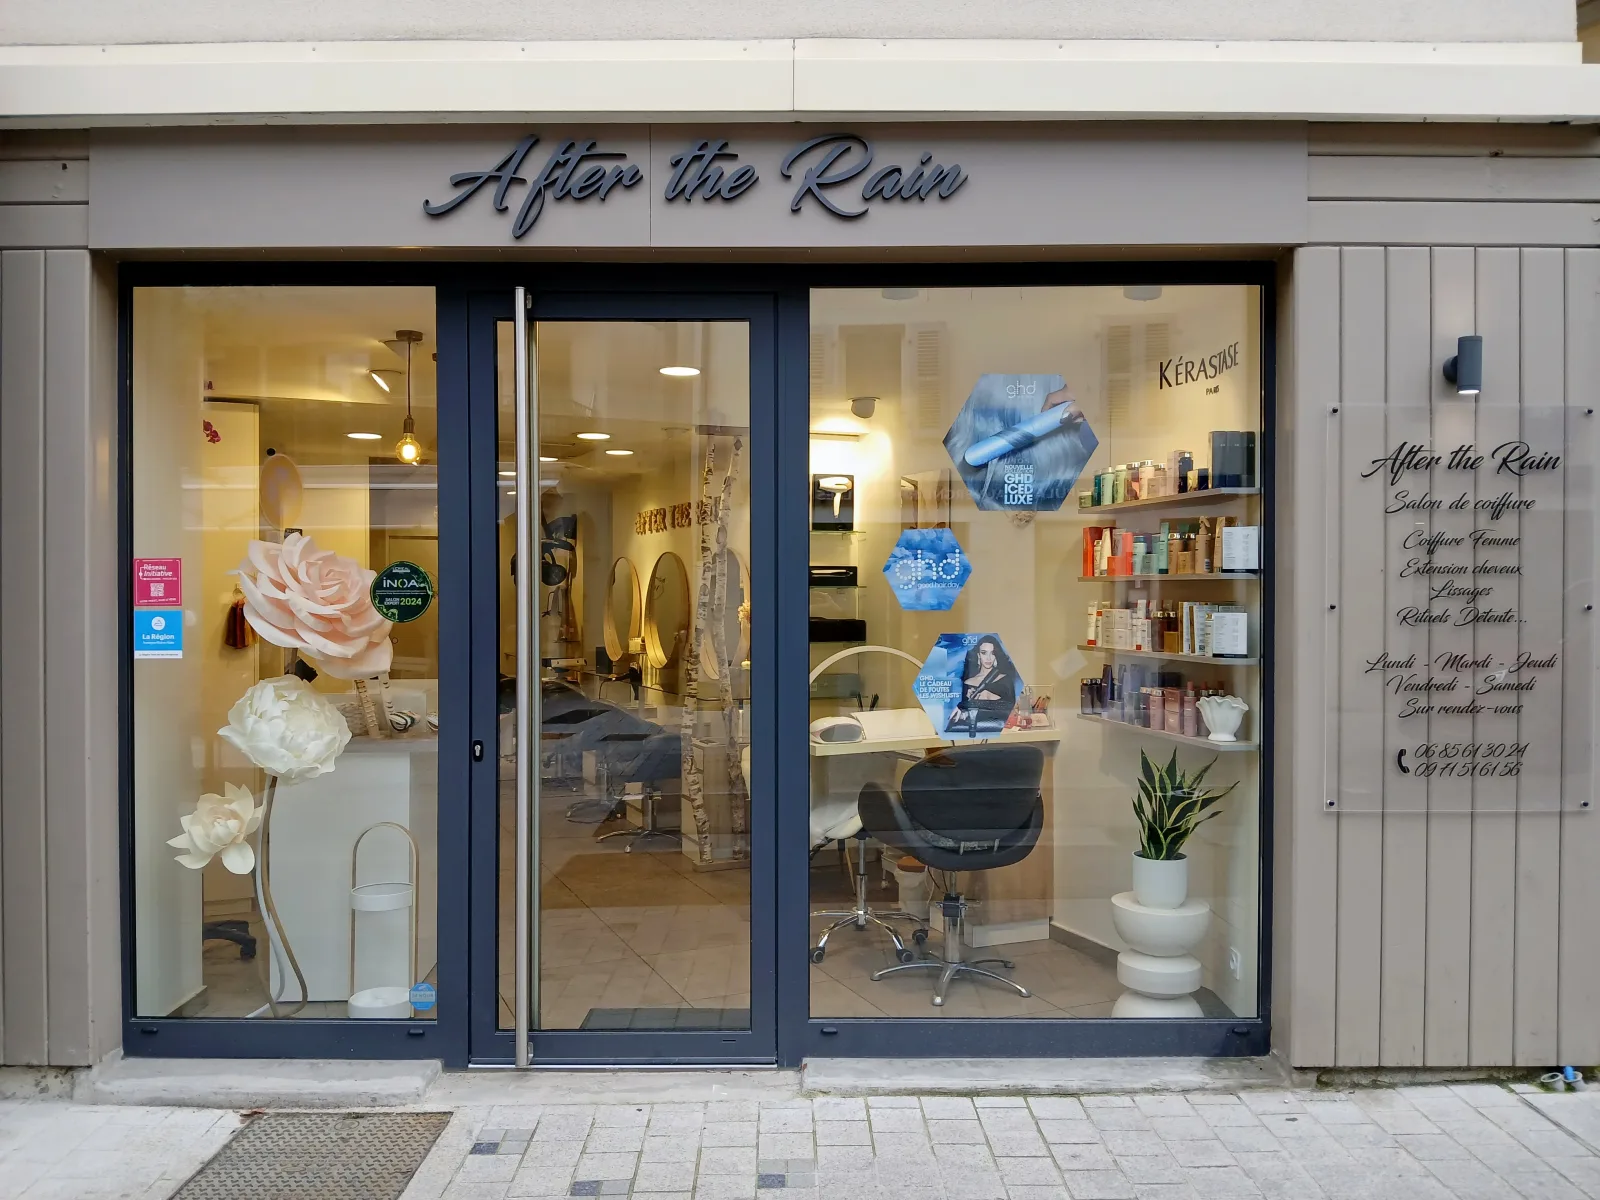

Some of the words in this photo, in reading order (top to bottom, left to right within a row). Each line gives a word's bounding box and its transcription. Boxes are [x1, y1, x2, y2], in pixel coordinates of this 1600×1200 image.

[422, 133, 644, 239] After
[664, 138, 760, 203] the
[780, 132, 969, 219] Rain
[1159, 341, 1239, 390] KÉRASTASE
[1006, 380, 1037, 399] ghd
[1361, 441, 1443, 486] After
[1447, 444, 1485, 470] the
[1491, 440, 1564, 477] Rain
[1004, 473, 1034, 484] GHD
[1004, 483, 1034, 495] ICED
[1004, 494, 1033, 505] LUXE
[1385, 490, 1443, 514] Salon
[1449, 492, 1470, 510] de
[1474, 492, 1536, 520] coiffure
[1403, 529, 1465, 555] Coiffure
[1469, 528, 1521, 549] Femme
[143, 563, 166, 571] Réseau
[895, 548, 960, 590] ghd
[1400, 557, 1469, 578] Extension
[1472, 559, 1524, 576] cheveux
[400, 597, 422, 606] 2024
[1430, 579, 1494, 604] Lissages
[1396, 606, 1451, 627] Rituels
[150, 633, 175, 641] Région
[961, 636, 978, 646] ghd
[1364, 652, 1417, 674] Lundi
[1434, 651, 1493, 673] Mardi
[1508, 651, 1558, 674] Jeudi
[1386, 673, 1459, 695] Vendredi
[1475, 674, 1537, 695] Samedi
[1398, 697, 1435, 719] Sur
[1437, 698, 1524, 715] rendez-vous
